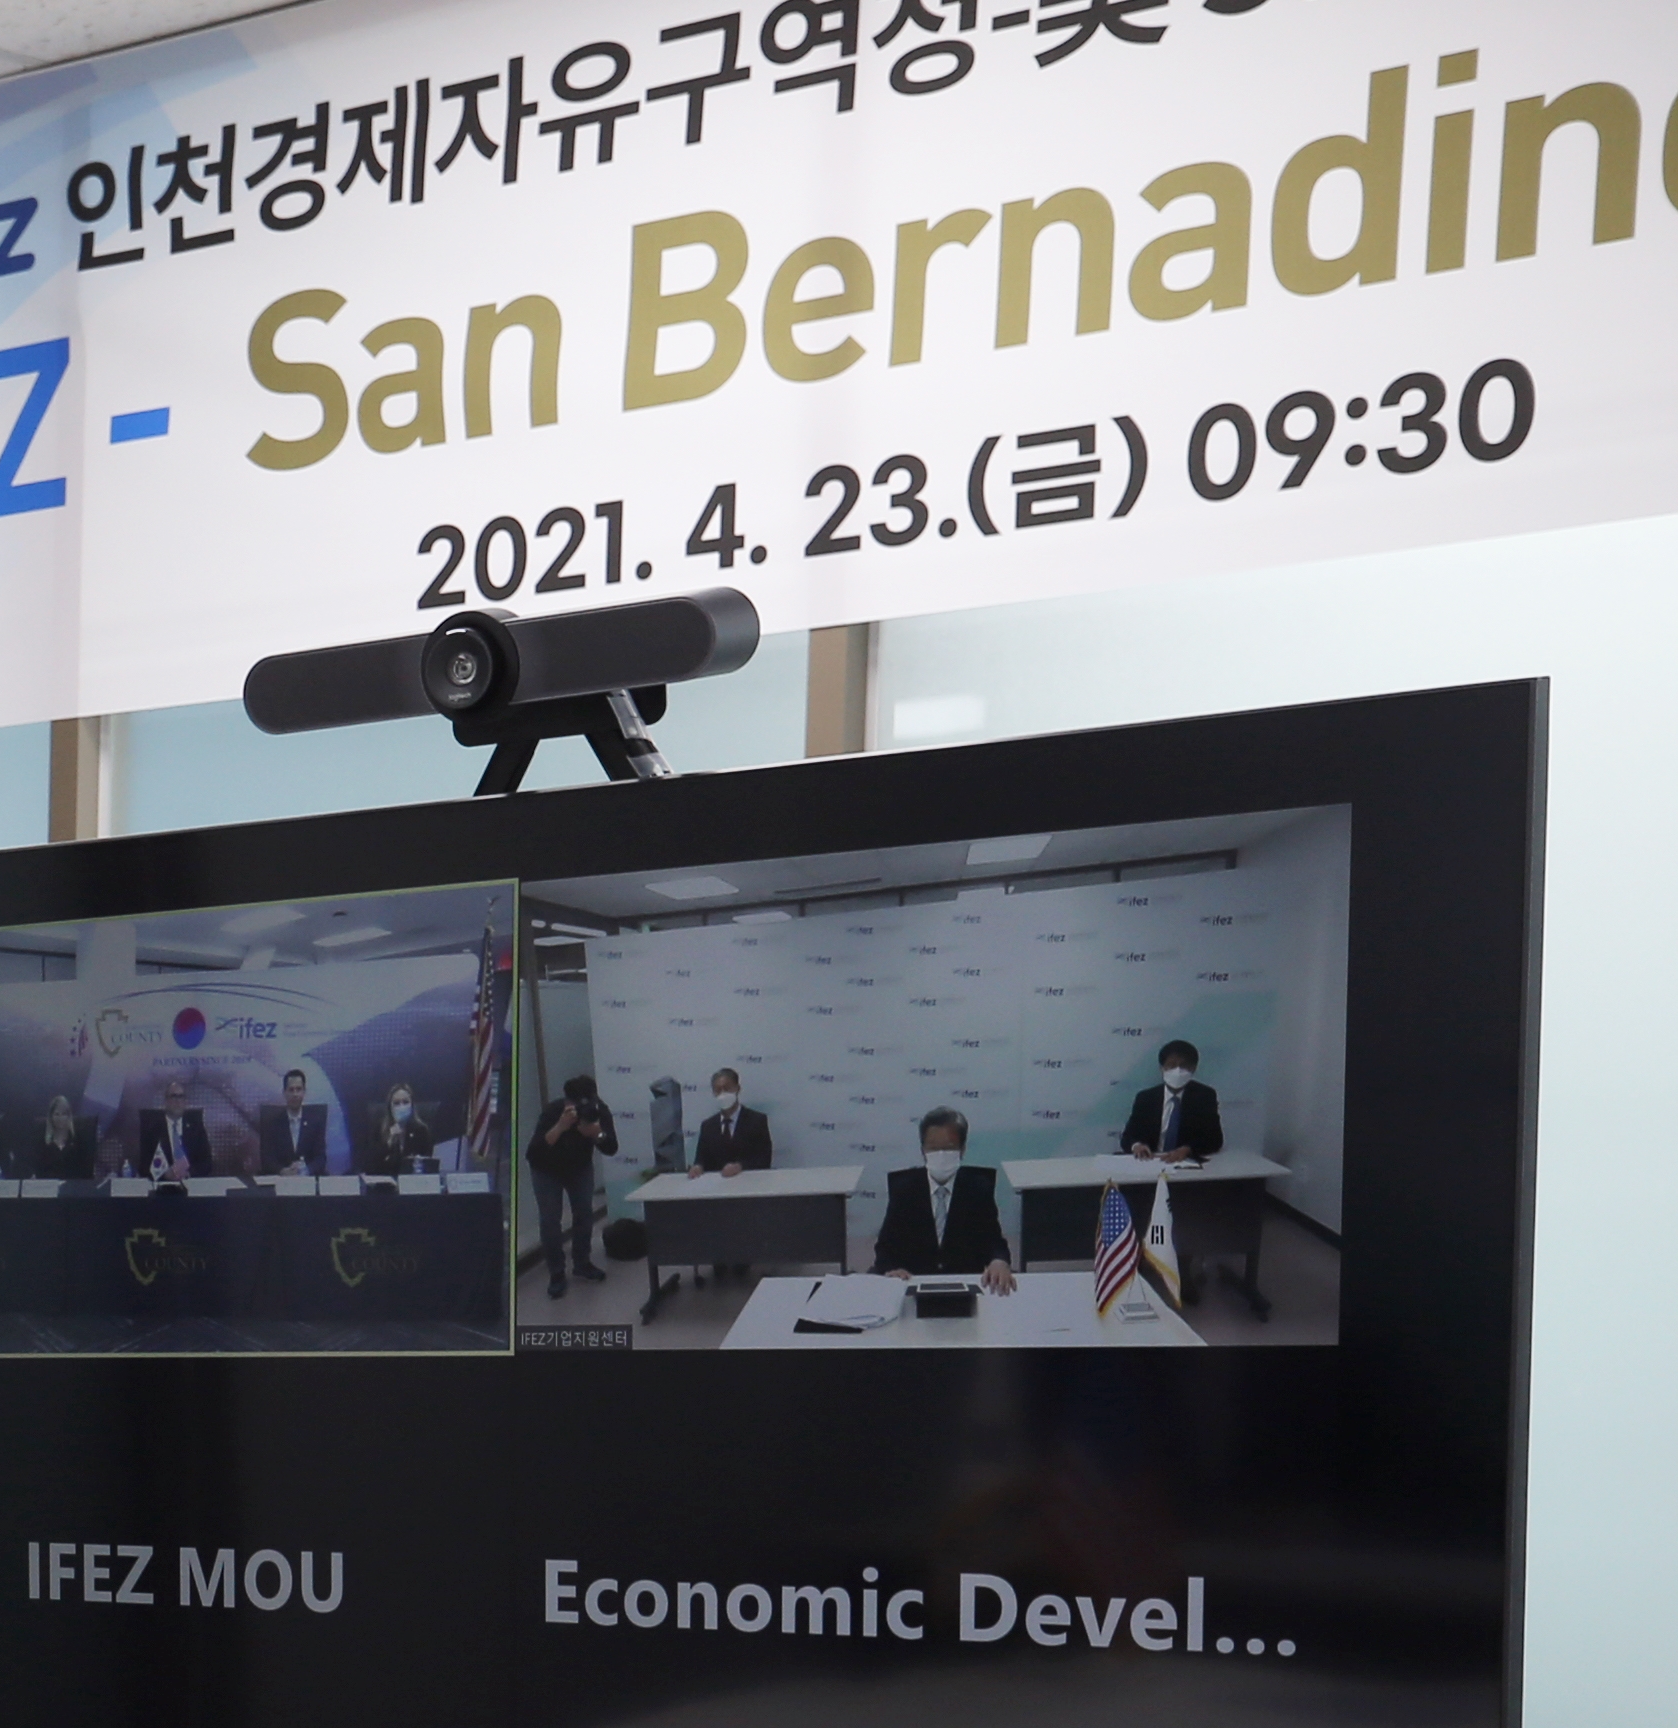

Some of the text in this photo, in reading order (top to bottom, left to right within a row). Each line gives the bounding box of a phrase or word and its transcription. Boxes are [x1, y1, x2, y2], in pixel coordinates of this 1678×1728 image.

[246, 288, 562, 471] San
[621, 48, 1678, 412] Bernadin
[417, 500, 654, 610] 2021.
[685, 483, 769, 568] 4.
[1188, 358, 1536, 501] 09:30
[238, 1016, 278, 1040] ifez
[28, 1541, 343, 1613] IFEZ MOU
[545, 1559, 1297, 1657] Economic Devel...
